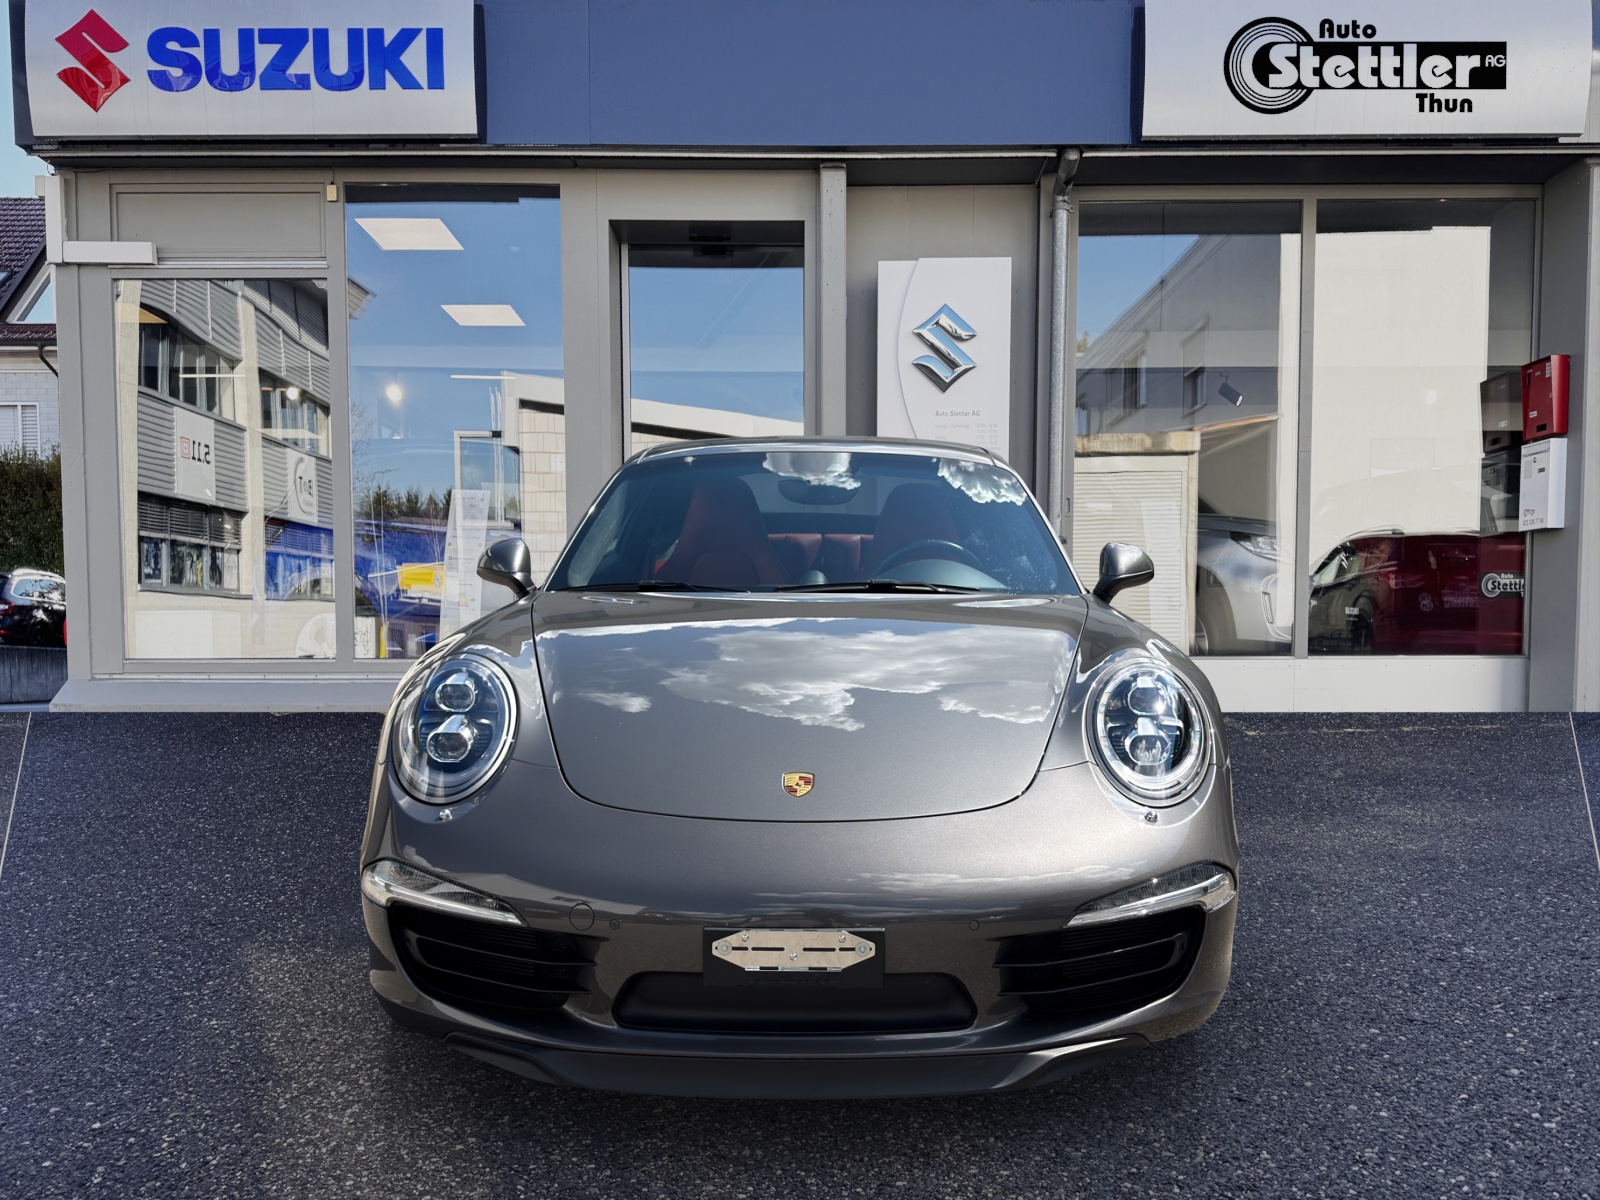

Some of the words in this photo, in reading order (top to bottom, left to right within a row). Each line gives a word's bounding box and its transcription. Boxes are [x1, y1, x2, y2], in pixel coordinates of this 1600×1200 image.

[1318, 18, 1377, 39] Auto
[147, 26, 445, 92] SUZUKI
[1268, 42, 1481, 89] Stettler
[1485, 54, 1506, 68] AG
[1415, 92, 1473, 113] Thun
